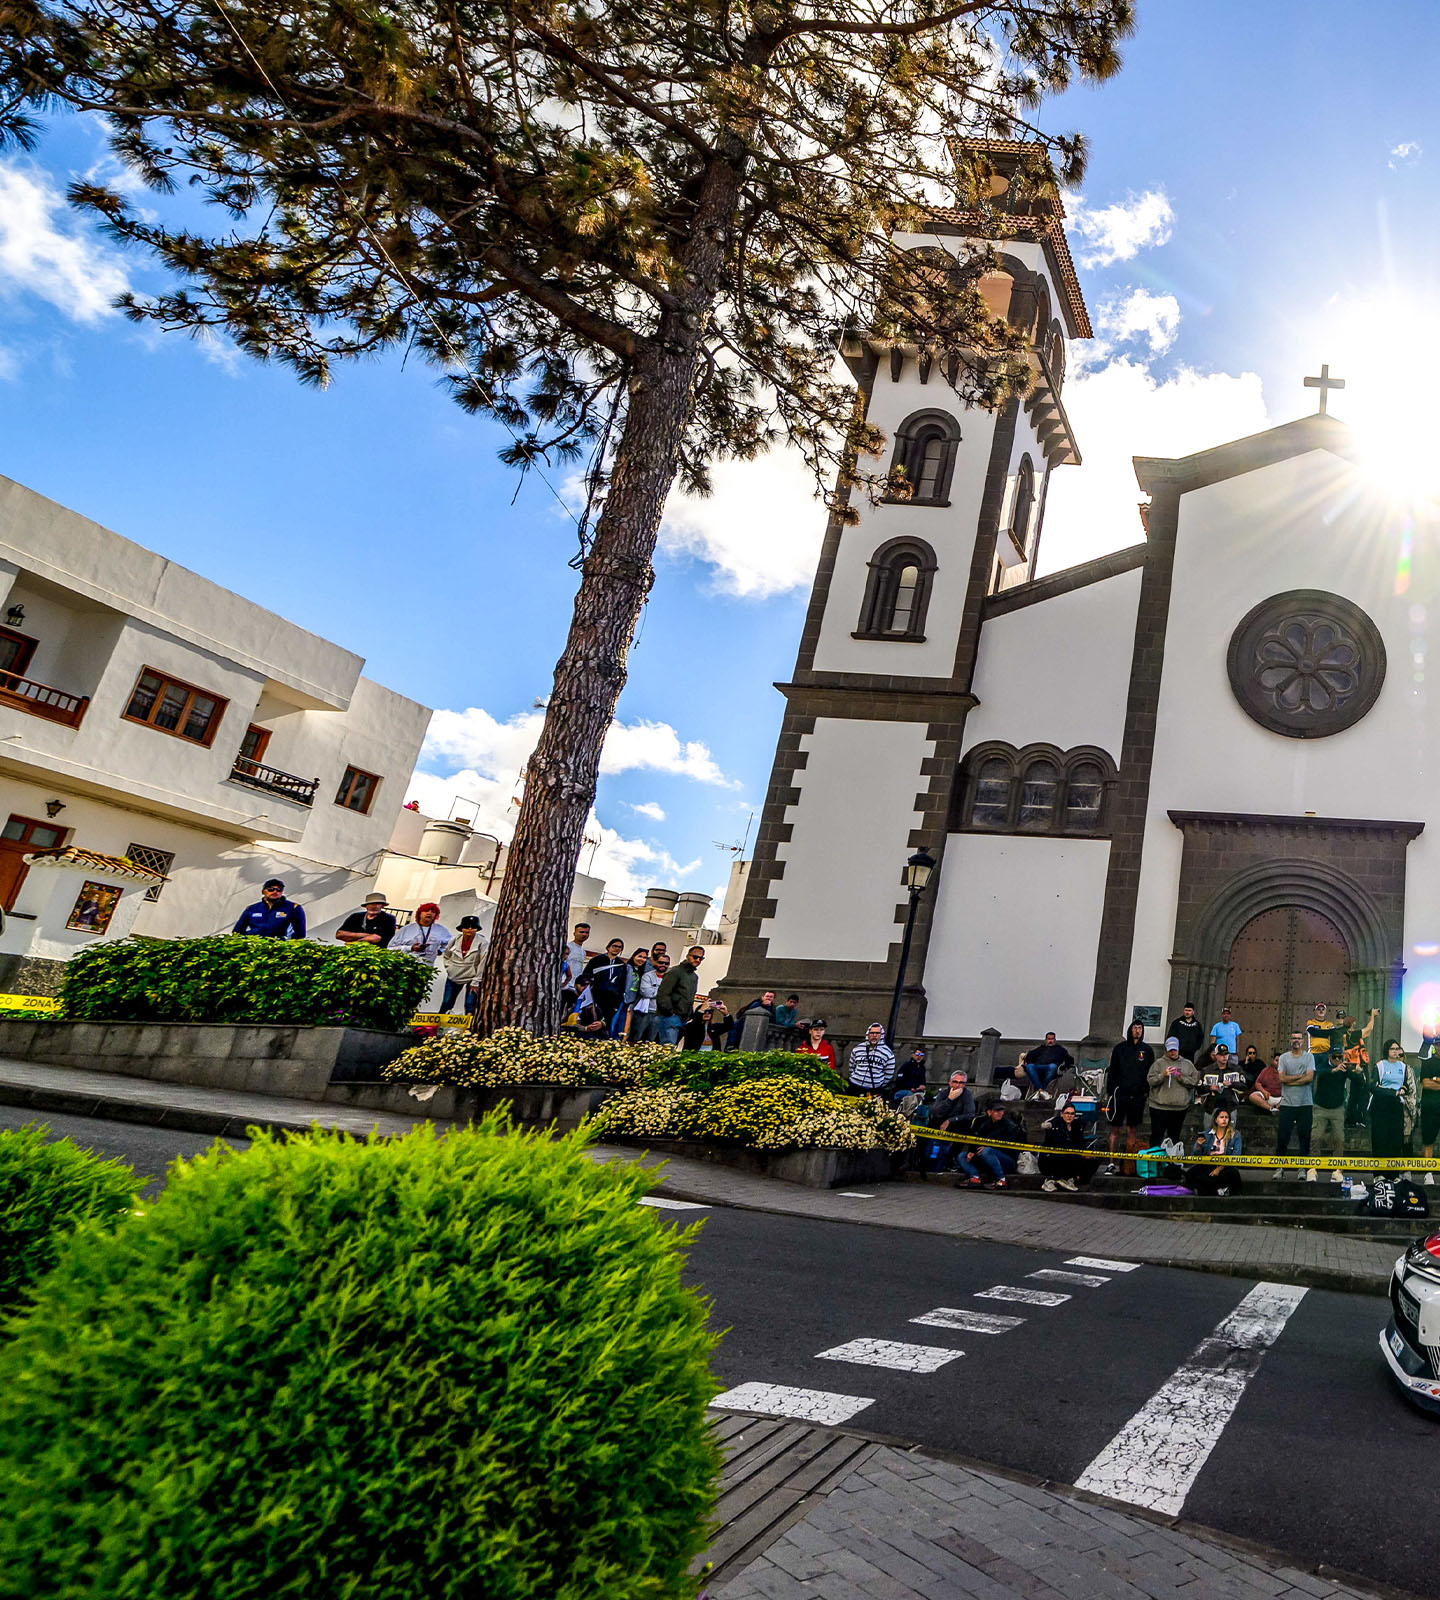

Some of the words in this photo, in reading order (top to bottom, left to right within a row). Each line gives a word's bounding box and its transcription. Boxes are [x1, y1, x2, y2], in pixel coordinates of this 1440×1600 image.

[23, 998, 52, 1008] ZONA
[1290, 1158, 1322, 1166] PUBLICO
[1386, 1160, 1405, 1168] ZONA
[1407, 1160, 1437, 1168] PUBLICO
